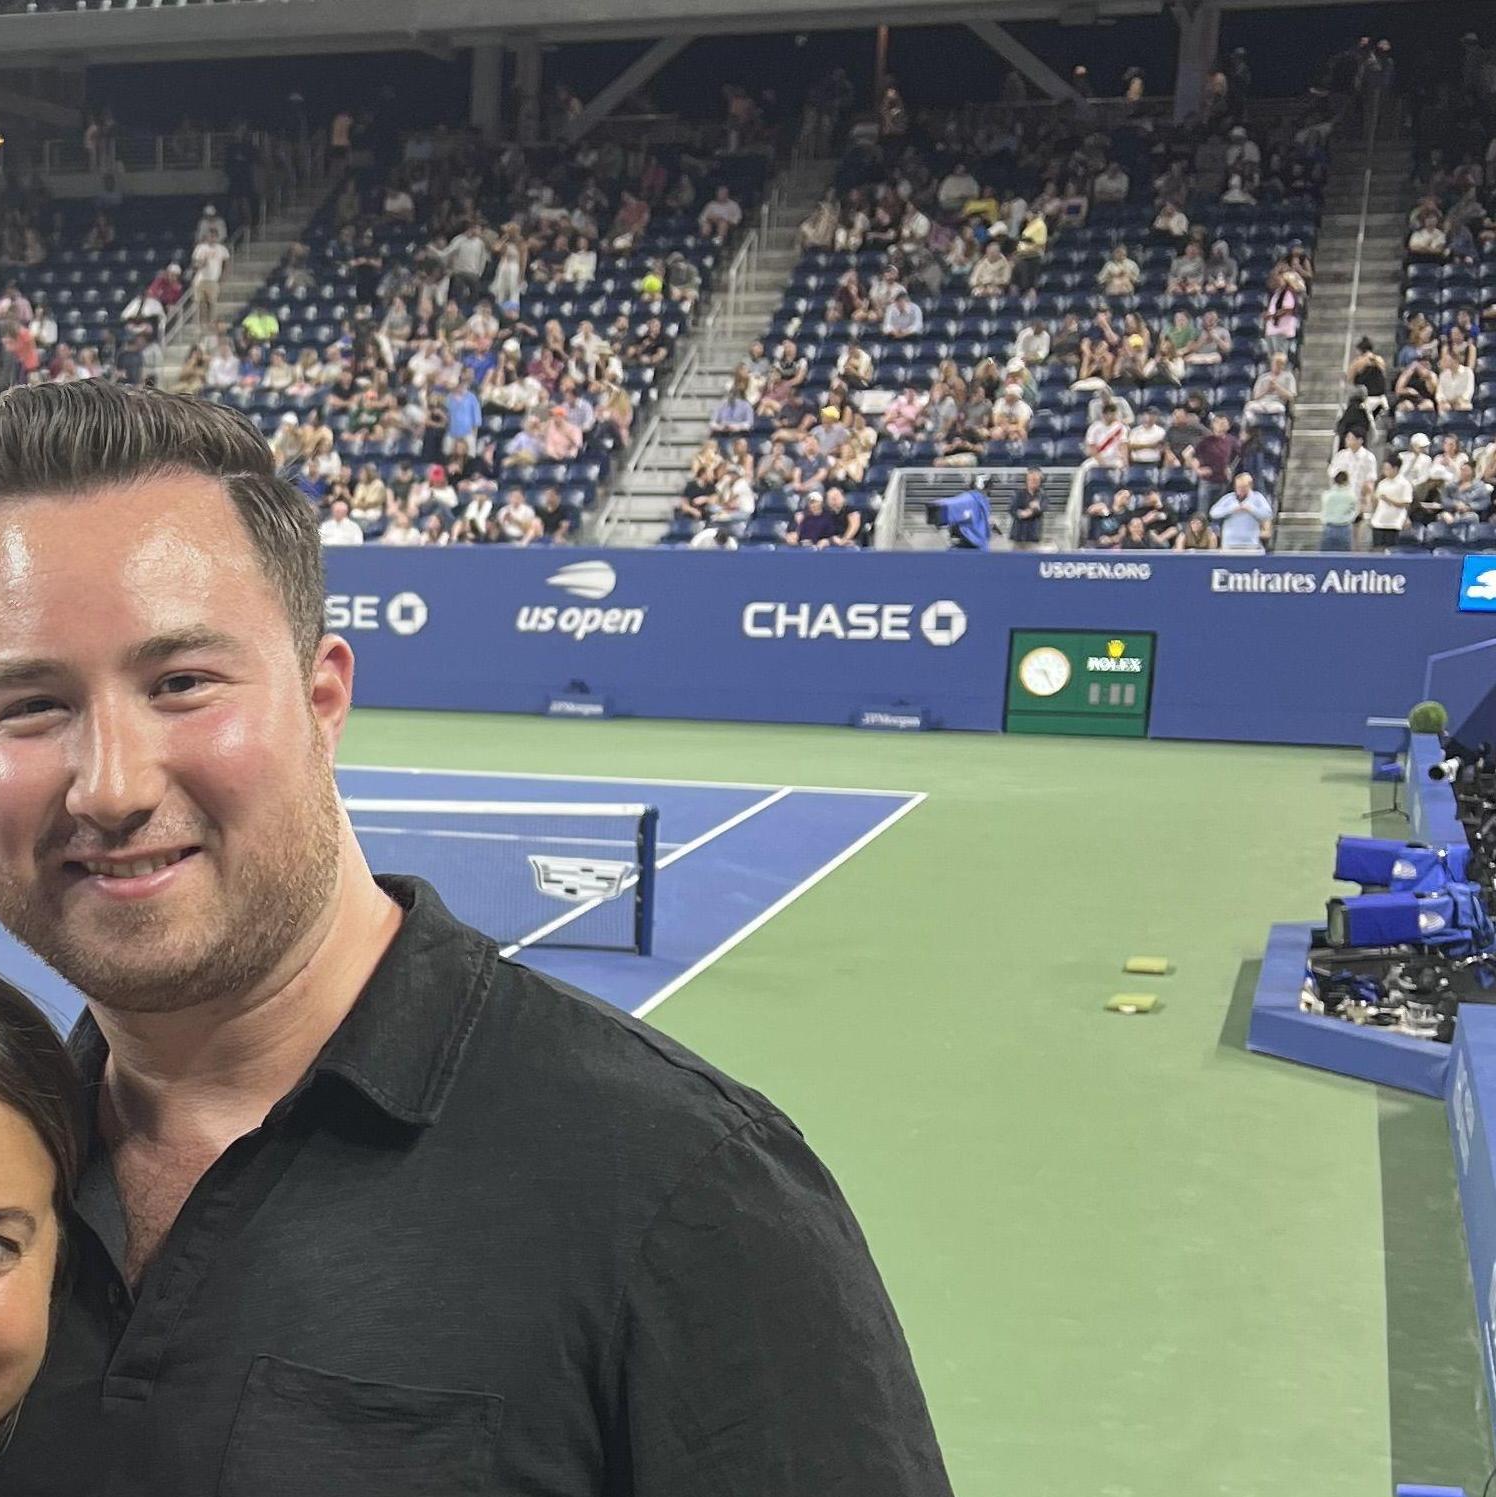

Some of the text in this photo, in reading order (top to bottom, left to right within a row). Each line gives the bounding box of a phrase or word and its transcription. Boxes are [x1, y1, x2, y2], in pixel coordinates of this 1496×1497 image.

[1211, 568, 1406, 594] Emirates Airline
[516, 605, 646, 641] us open
[742, 601, 914, 641] CHASE
[1086, 656, 1142, 672] ROLEX
